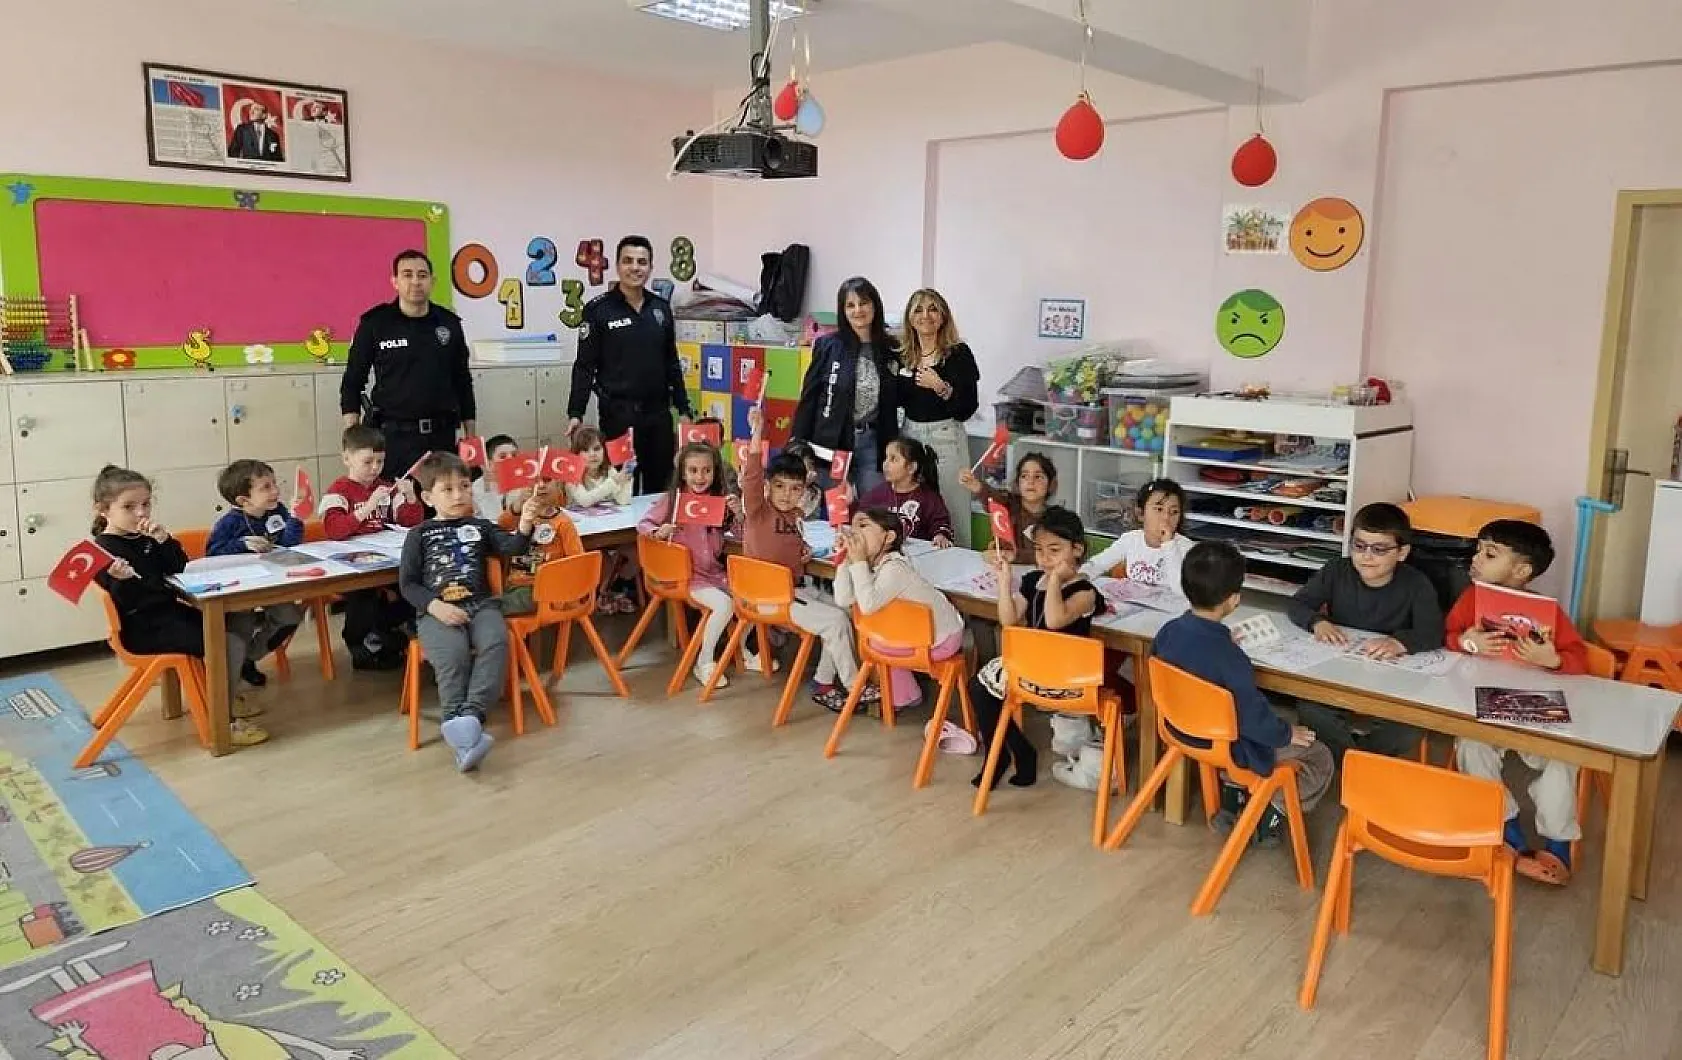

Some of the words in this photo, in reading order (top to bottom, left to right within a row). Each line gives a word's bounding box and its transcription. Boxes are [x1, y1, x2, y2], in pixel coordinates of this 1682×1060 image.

[498, 278, 524, 329] 1
[526, 237, 557, 286] 2
[560, 279, 584, 329] 3
[575, 239, 608, 286] 4
[670, 236, 696, 282] 8
